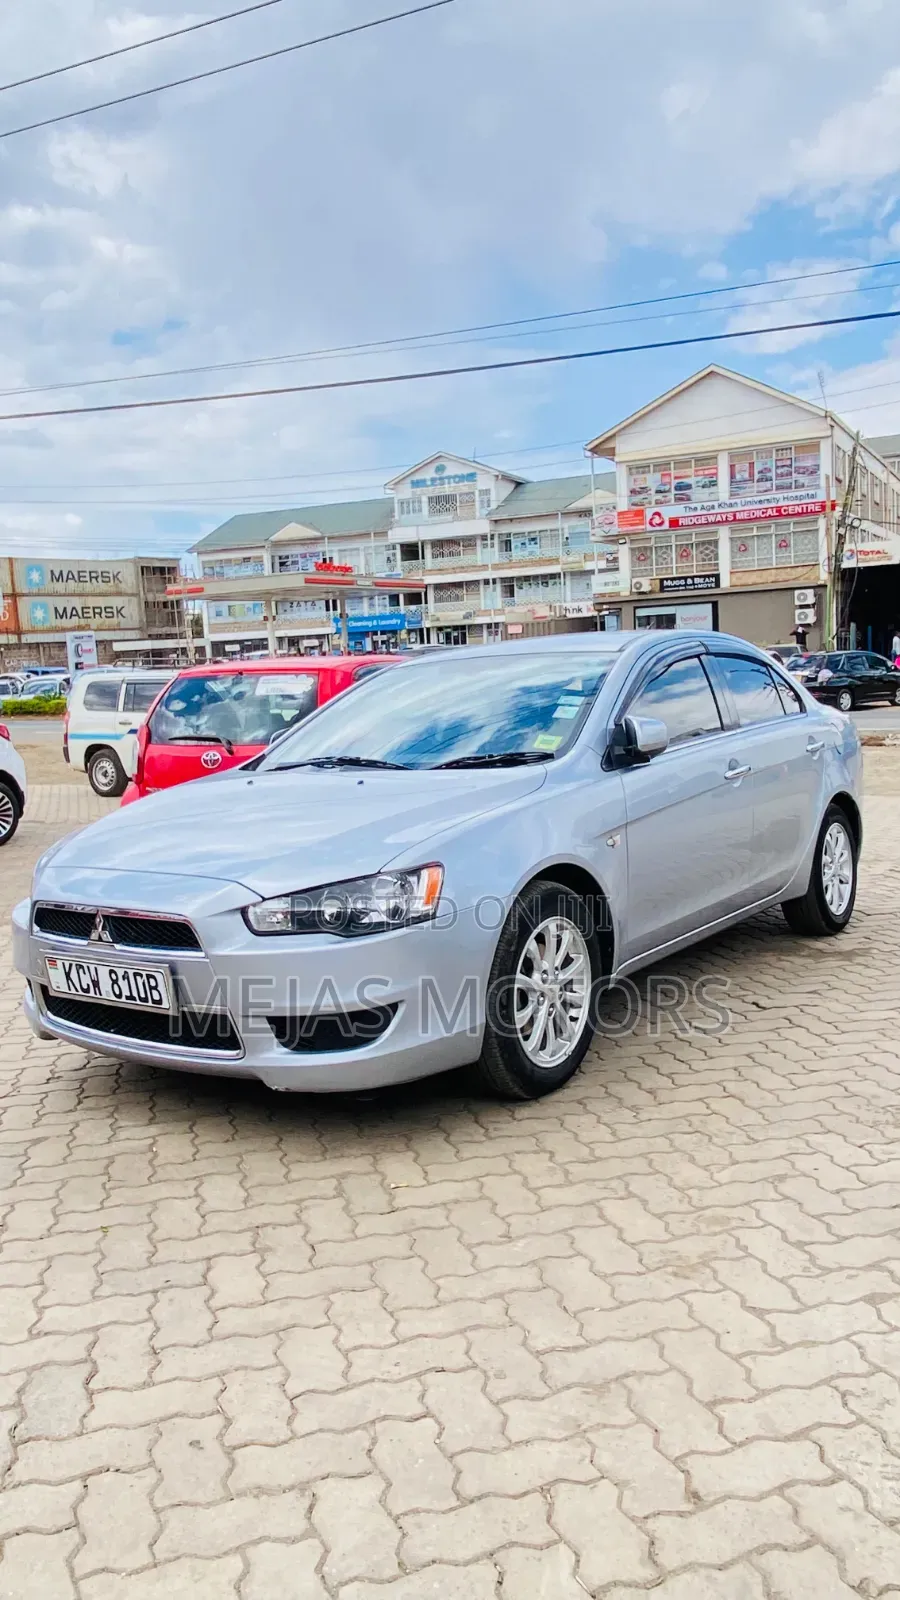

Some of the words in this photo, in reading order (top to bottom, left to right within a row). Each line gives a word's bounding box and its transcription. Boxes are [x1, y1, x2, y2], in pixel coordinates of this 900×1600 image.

[683, 505, 698, 513] The
[701, 502, 716, 512] Aga
[717, 499, 738, 510] Khan
[740, 495, 780, 507] University
[782, 491, 818, 502] Hospital
[679, 512, 734, 526] RIDGEWAYS
[735, 507, 779, 521] MEDICAL
[781, 502, 822, 515] CENTRE
[50, 569, 122, 583] MAERSK
[54, 605, 126, 619] MAERSK
[348, 620, 373, 628] Cleaning
[378, 618, 401, 626] Laundry
[62, 962, 102, 996] KCW
[108, 968, 163, 1005] 810B
